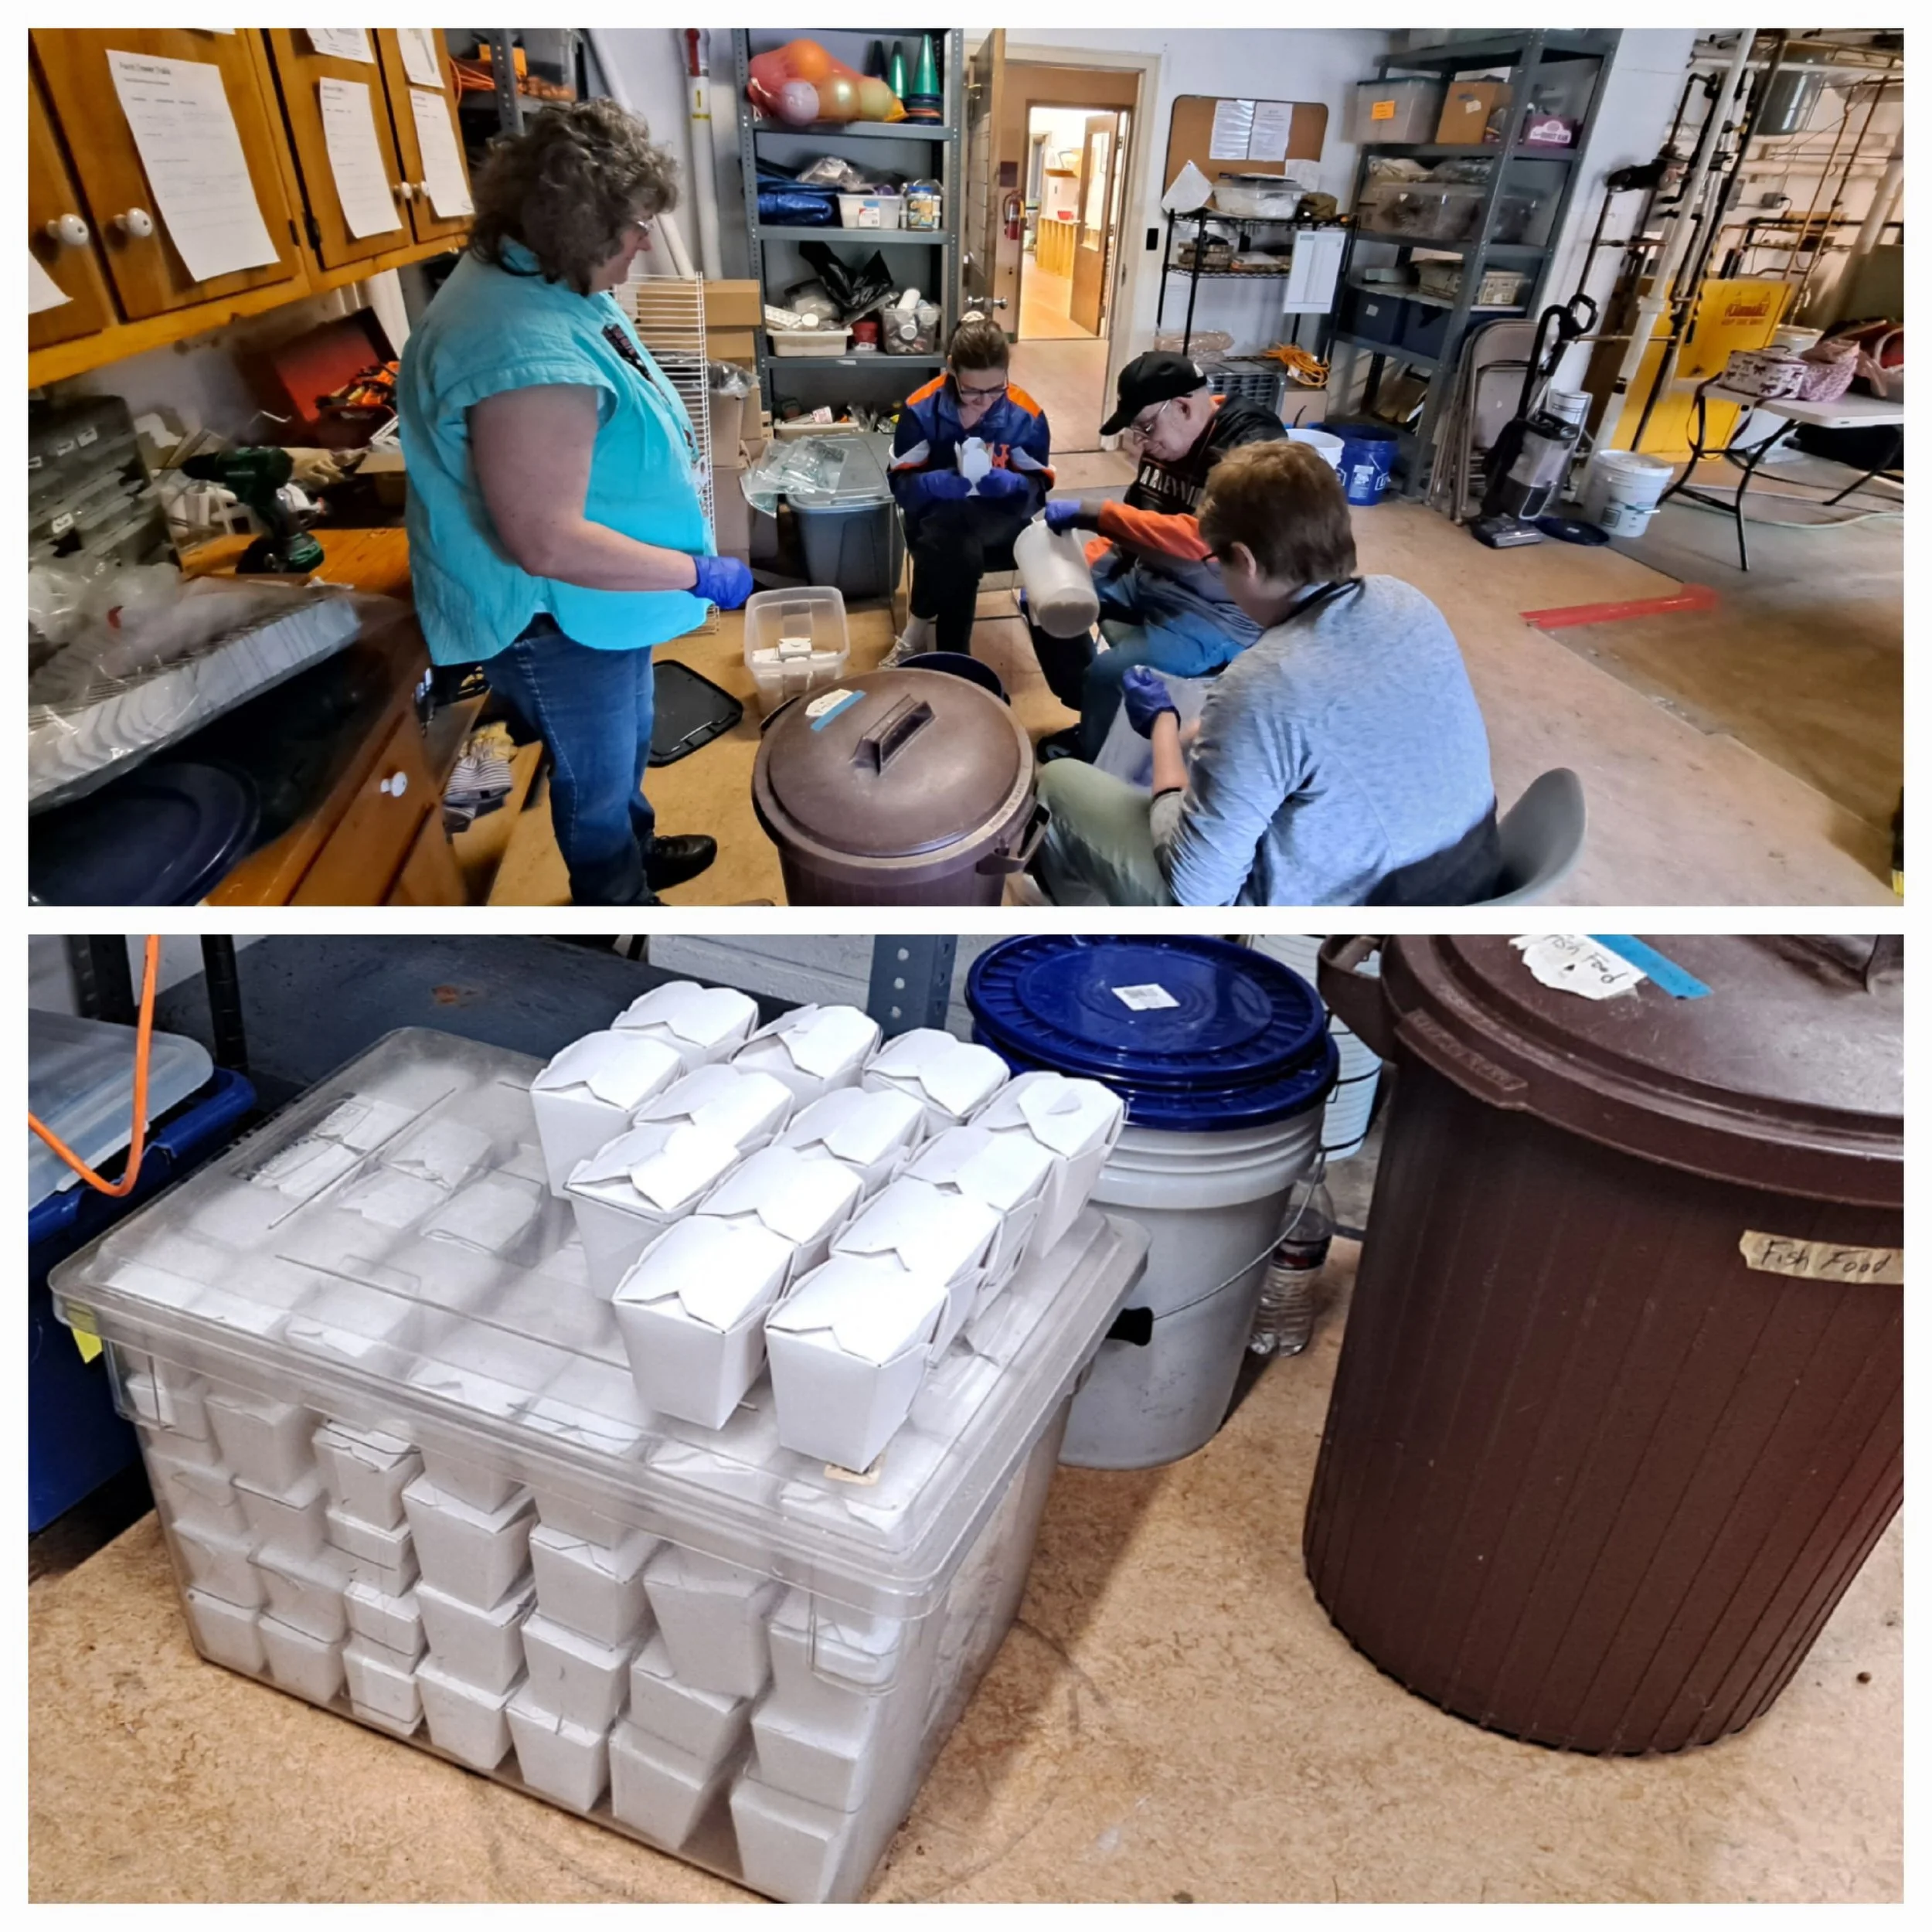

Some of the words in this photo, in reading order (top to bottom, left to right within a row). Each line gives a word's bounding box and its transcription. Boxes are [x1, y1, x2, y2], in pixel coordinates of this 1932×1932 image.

[1580, 951, 1629, 985] Food
[1760, 1239, 1810, 1271] Fish
[1819, 1249, 1892, 1274] Food
